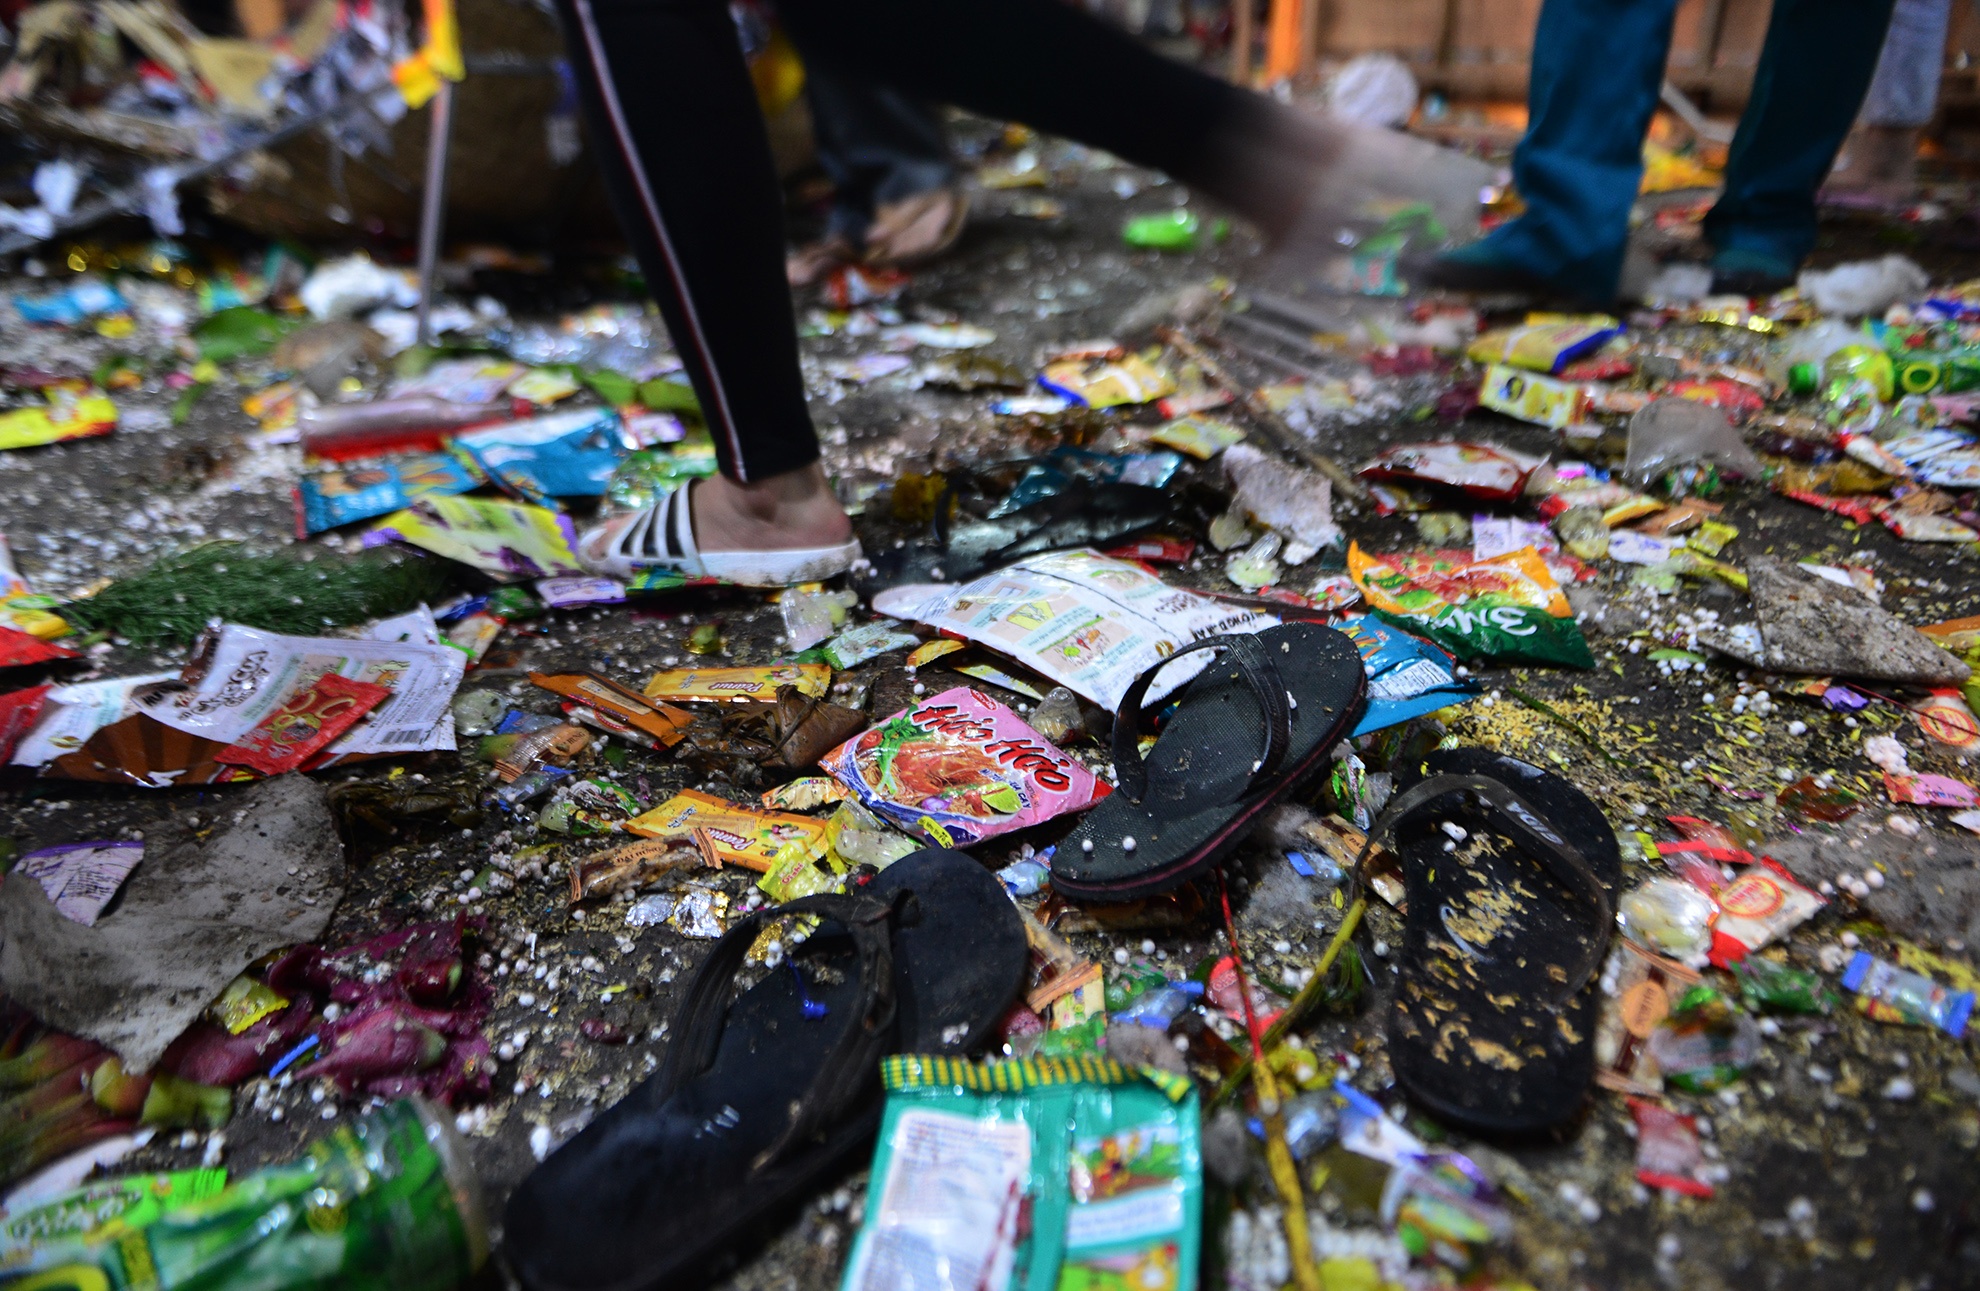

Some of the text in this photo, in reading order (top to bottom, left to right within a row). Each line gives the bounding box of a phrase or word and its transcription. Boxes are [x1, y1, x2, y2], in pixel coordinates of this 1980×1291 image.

[708, 681, 764, 693] Peanut
[707, 827, 757, 851] Peanu
[781, 863, 804, 885] Oishi
